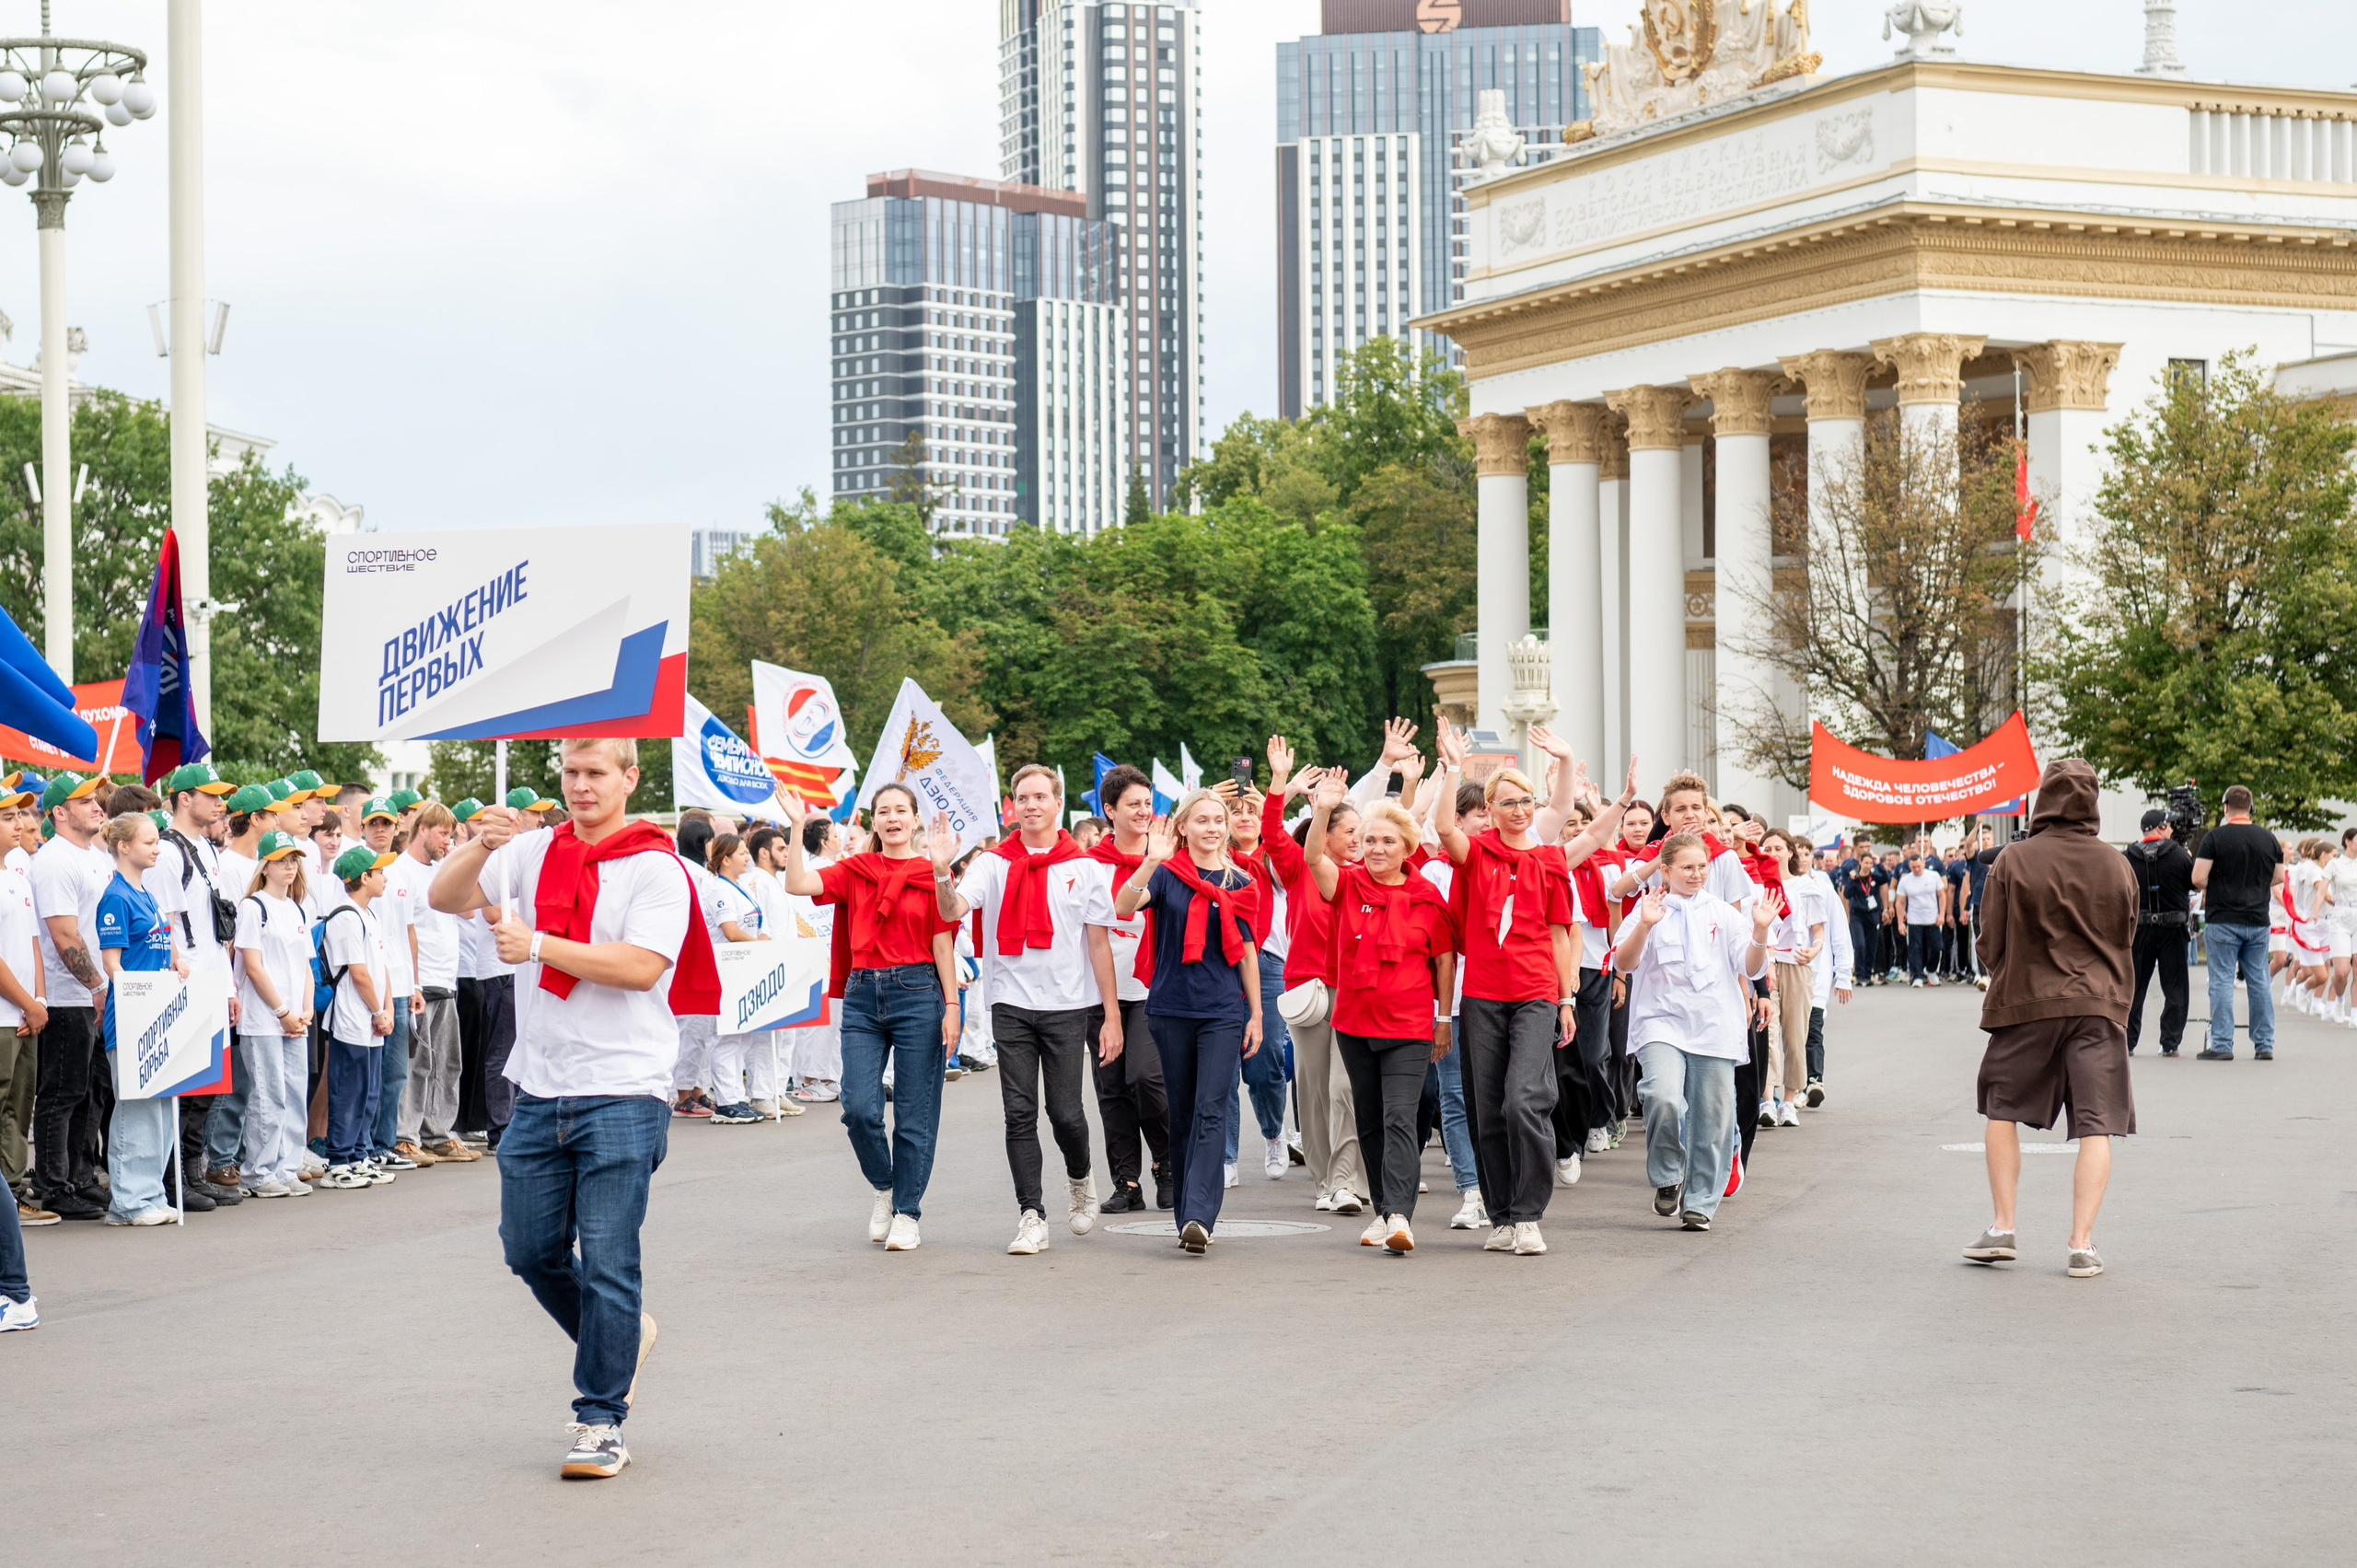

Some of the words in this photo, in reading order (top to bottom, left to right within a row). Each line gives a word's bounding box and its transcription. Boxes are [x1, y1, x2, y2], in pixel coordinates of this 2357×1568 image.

[347, 563, 415, 574] ШЕСТВИЕ
[378, 559, 528, 688] ДВИЖЕНИЕ
[378, 630, 484, 728] ПЕРВЫХ
[707, 733, 746, 757] СЕМЬЯ
[935, 768, 978, 822] ФЕДЕРАЦИЯ
[1831, 765, 1891, 793] НАДЕЖДА
[1893, 764, 1996, 794] ЧЕЛОВЕЧЕСТВА
[1842, 784, 1913, 805] ЗДОРОВОЕ
[1915, 778, 1997, 805] ОТЕЧЕСТВО!
[737, 962, 785, 1030] ДЗЮДО
[137, 985, 188, 1062] СПОРТИВНАЯ
[139, 1037, 169, 1090] БОРЬБА
